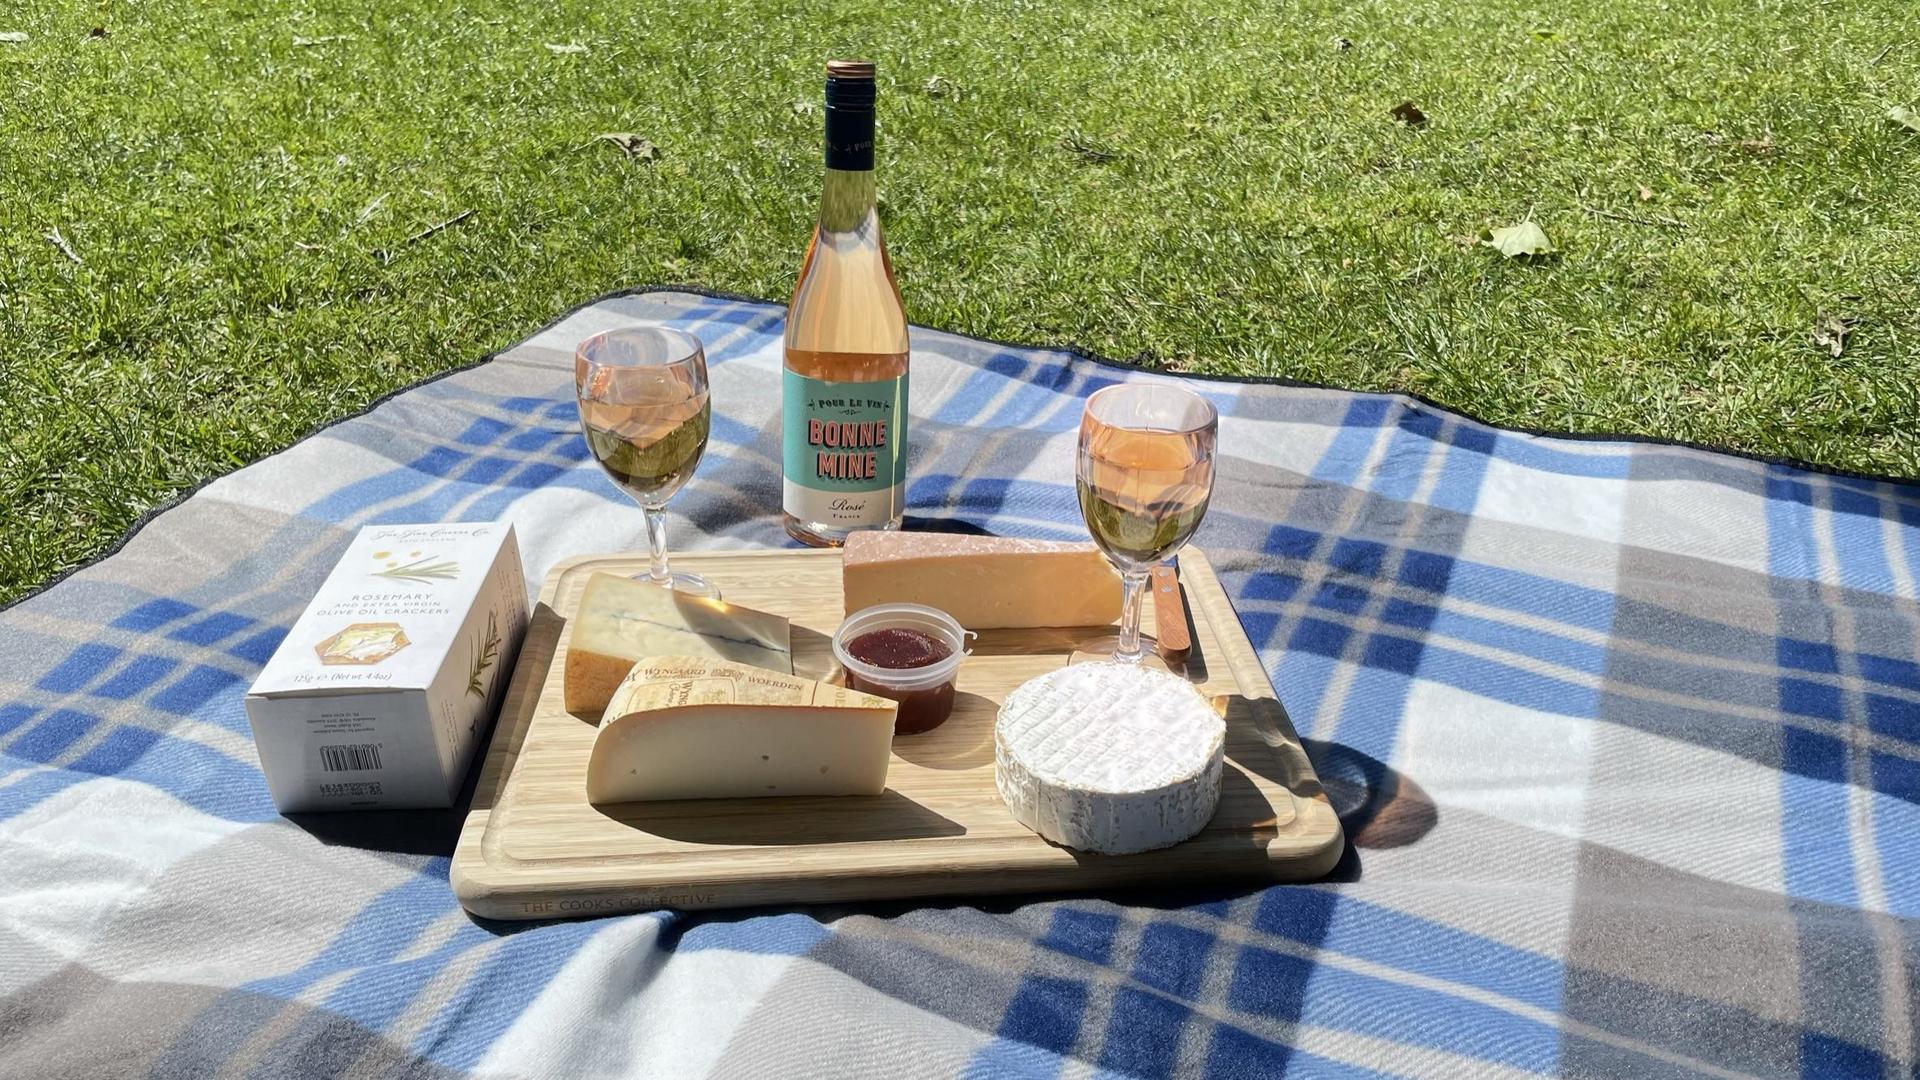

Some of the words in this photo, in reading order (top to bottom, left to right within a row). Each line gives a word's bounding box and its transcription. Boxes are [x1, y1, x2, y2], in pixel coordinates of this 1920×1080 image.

[819, 399, 845, 408] POUR
[849, 398, 864, 407] LE
[867, 399, 883, 408] VIN
[808, 419, 886, 448] BONNE
[817, 450, 877, 480] MINE
[828, 499, 865, 511] Rosé
[351, 593, 433, 601] ROSEMARY
[748, 676, 804, 691] WOERDEN
[521, 901, 553, 913] THE
[559, 899, 614, 912] COOKS
[619, 894, 716, 908] COLLECTIVE
